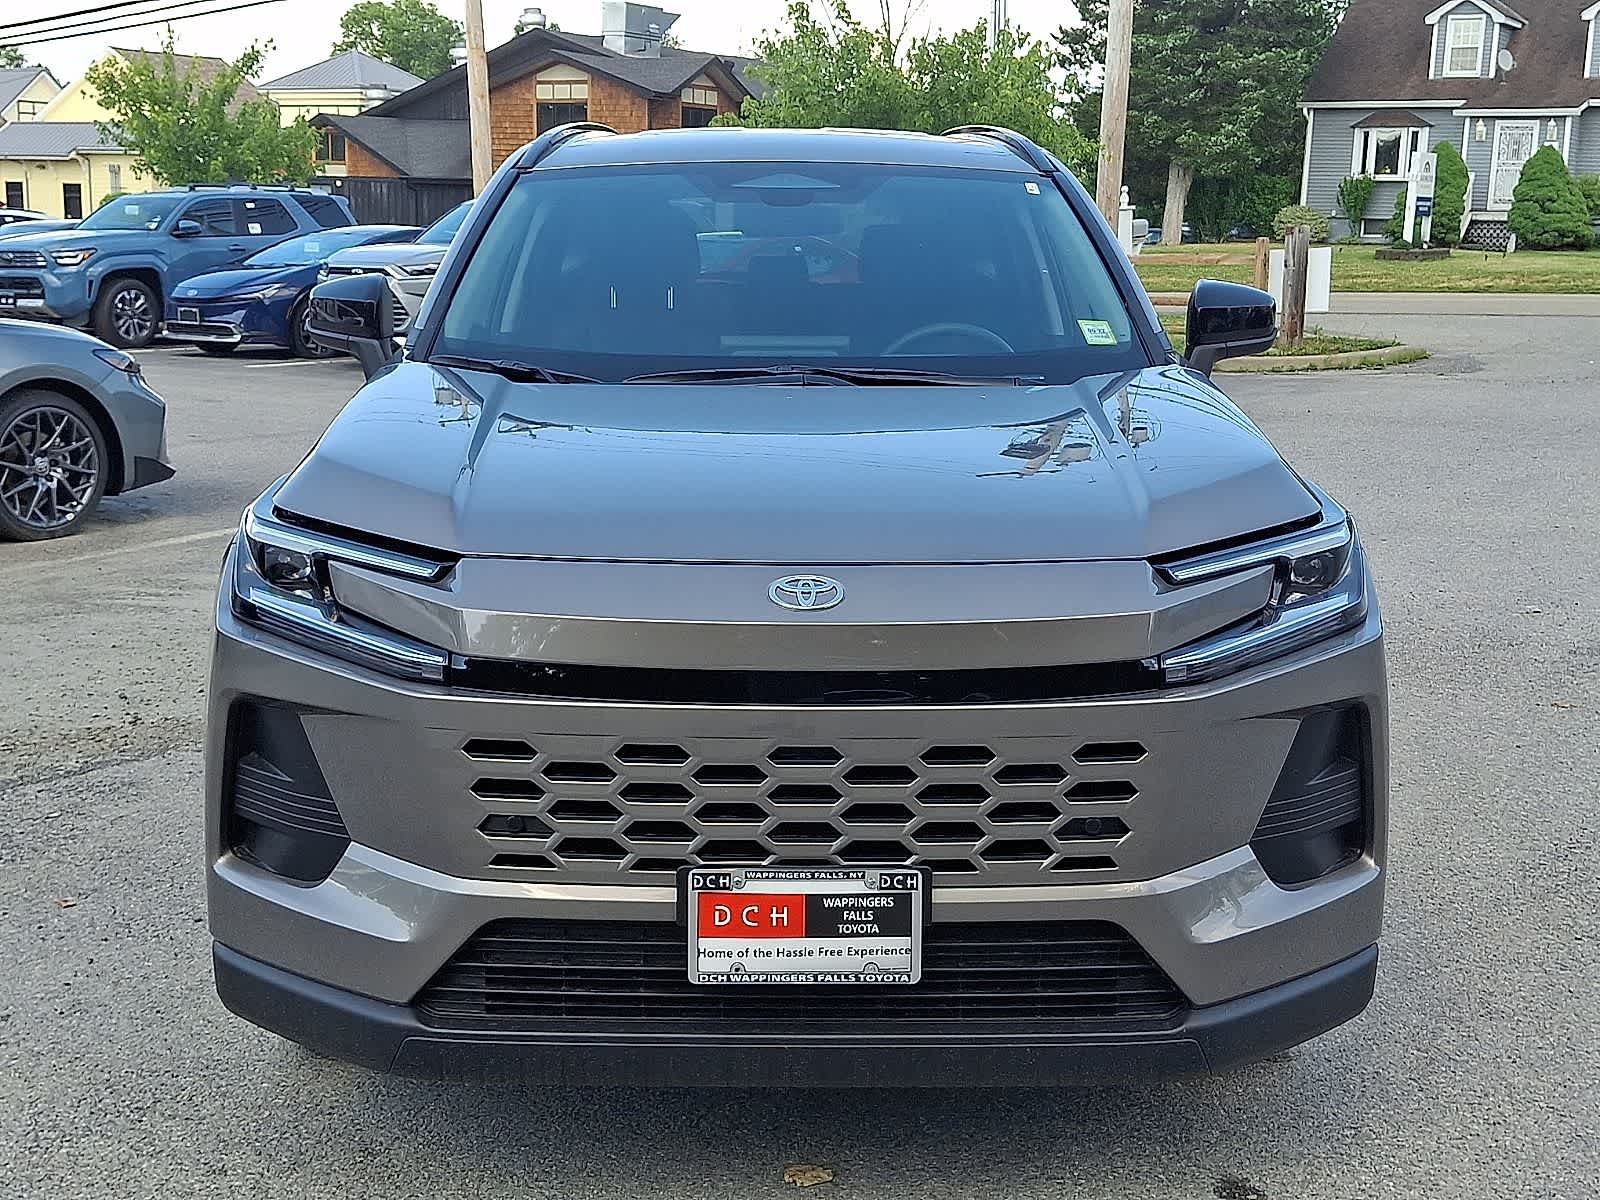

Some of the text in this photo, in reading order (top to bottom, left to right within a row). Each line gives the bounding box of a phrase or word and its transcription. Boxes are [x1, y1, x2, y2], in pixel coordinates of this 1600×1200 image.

[746, 871, 812, 879] WAPPINGERS
[850, 871, 864, 879] NY
[693, 875, 730, 888] DCH
[881, 875, 917, 889] DCH
[823, 897, 895, 908] WAPPINGERS
[713, 904, 789, 927] DCH
[843, 910, 874, 921] FALLS
[837, 923, 880, 934] TOYOTA
[697, 945, 912, 959] Home of the Hassle Free Experience
[699, 974, 910, 982] DCH WAPPINGERS FALLS TOYOTA
